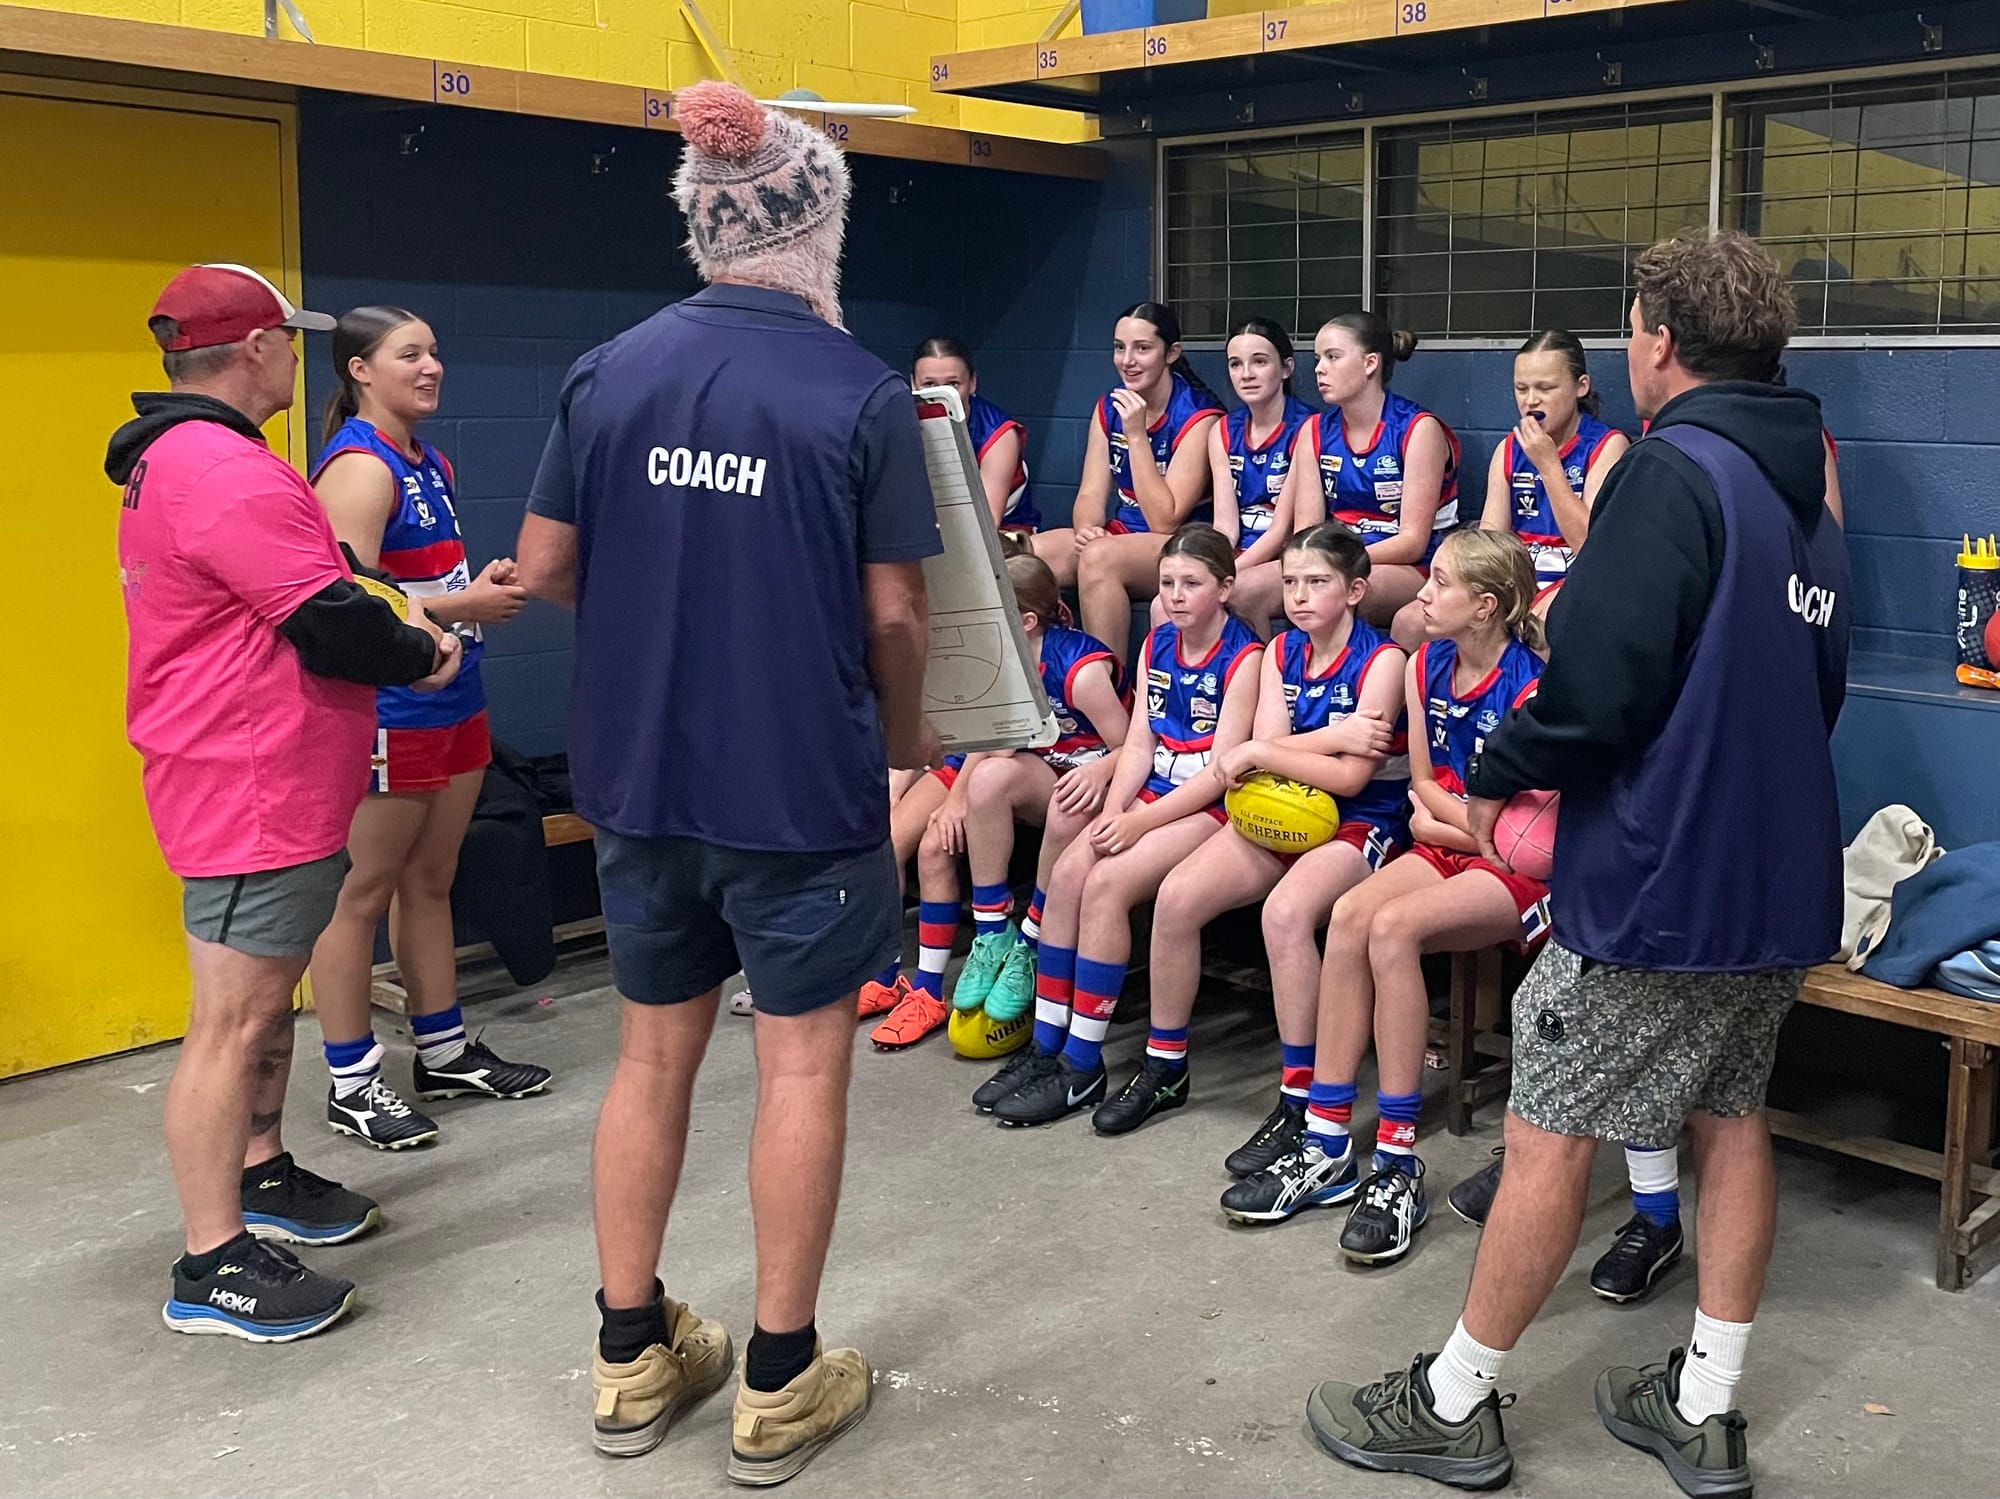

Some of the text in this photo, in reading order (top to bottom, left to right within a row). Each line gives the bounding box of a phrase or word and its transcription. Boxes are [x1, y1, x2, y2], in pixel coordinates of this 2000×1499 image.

[1402, 2, 1427, 24] 38
[1266, 20, 1288, 41] 37
[1147, 37, 1167, 56] 36
[1040, 51, 1057, 69] 35
[932, 63, 949, 81] 34
[440, 72, 471, 95] 30
[648, 99, 670, 118] 31
[827, 123, 848, 141] 32
[973, 141, 992, 157] 33
[647, 446, 767, 497] COACH
[1247, 822, 1308, 842] SHERRIN
[208, 1287, 258, 1315] HOKA
